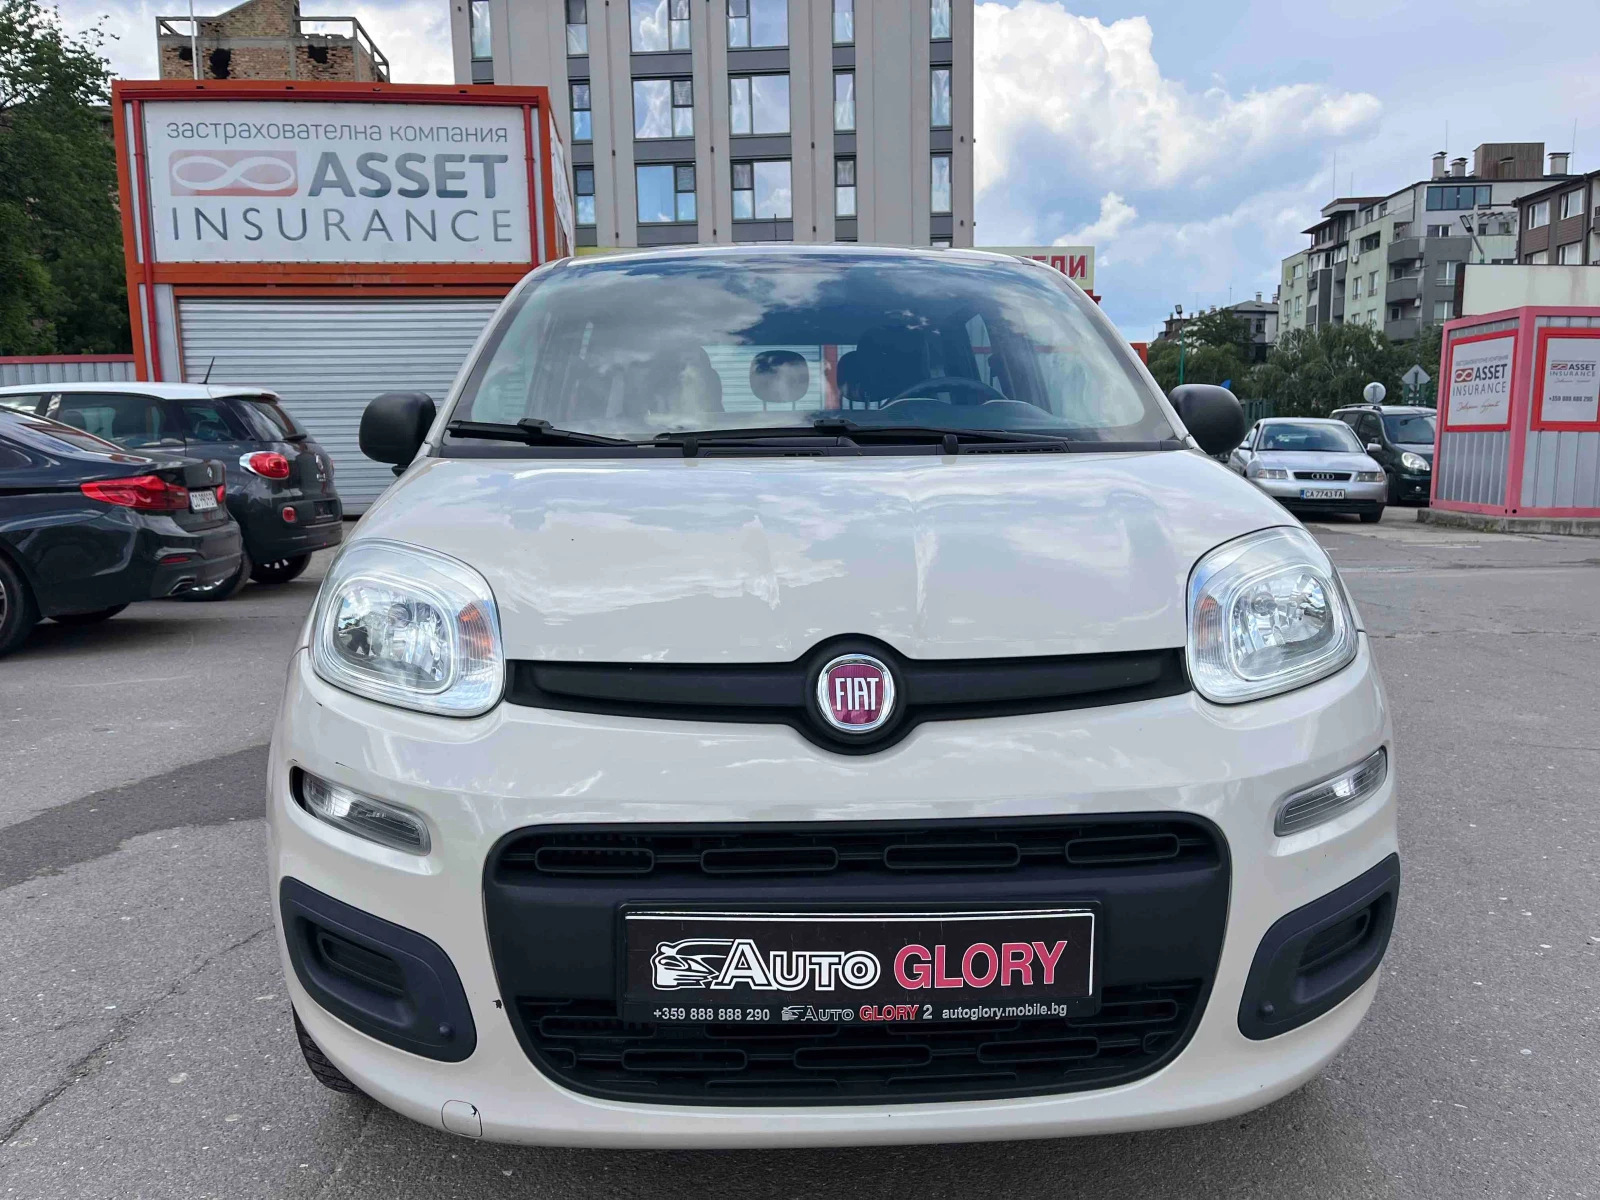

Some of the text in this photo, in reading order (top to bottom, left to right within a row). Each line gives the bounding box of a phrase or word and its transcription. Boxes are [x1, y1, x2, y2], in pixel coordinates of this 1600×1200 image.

[166, 121, 508, 144] застрахователна компания
[307, 151, 509, 199] ASSET
[172, 207, 513, 242] INSURANCE
[1473, 363, 1508, 382] ASSET
[1568, 363, 1596, 371] ASSET
[1452, 381, 1507, 396] INSURANCE
[834, 677, 880, 711] FIAT
[893, 940, 1068, 990] GLORY
[653, 1007, 686, 1020] +359
[690, 1008, 714, 1020] 888
[718, 1008, 742, 1021] 888
[746, 1009, 770, 1021] 290
[859, 1005, 920, 1021] GLORY
[923, 1005, 933, 1020] 2
[942, 1003, 1068, 1021] autoglory.mobile.bg
